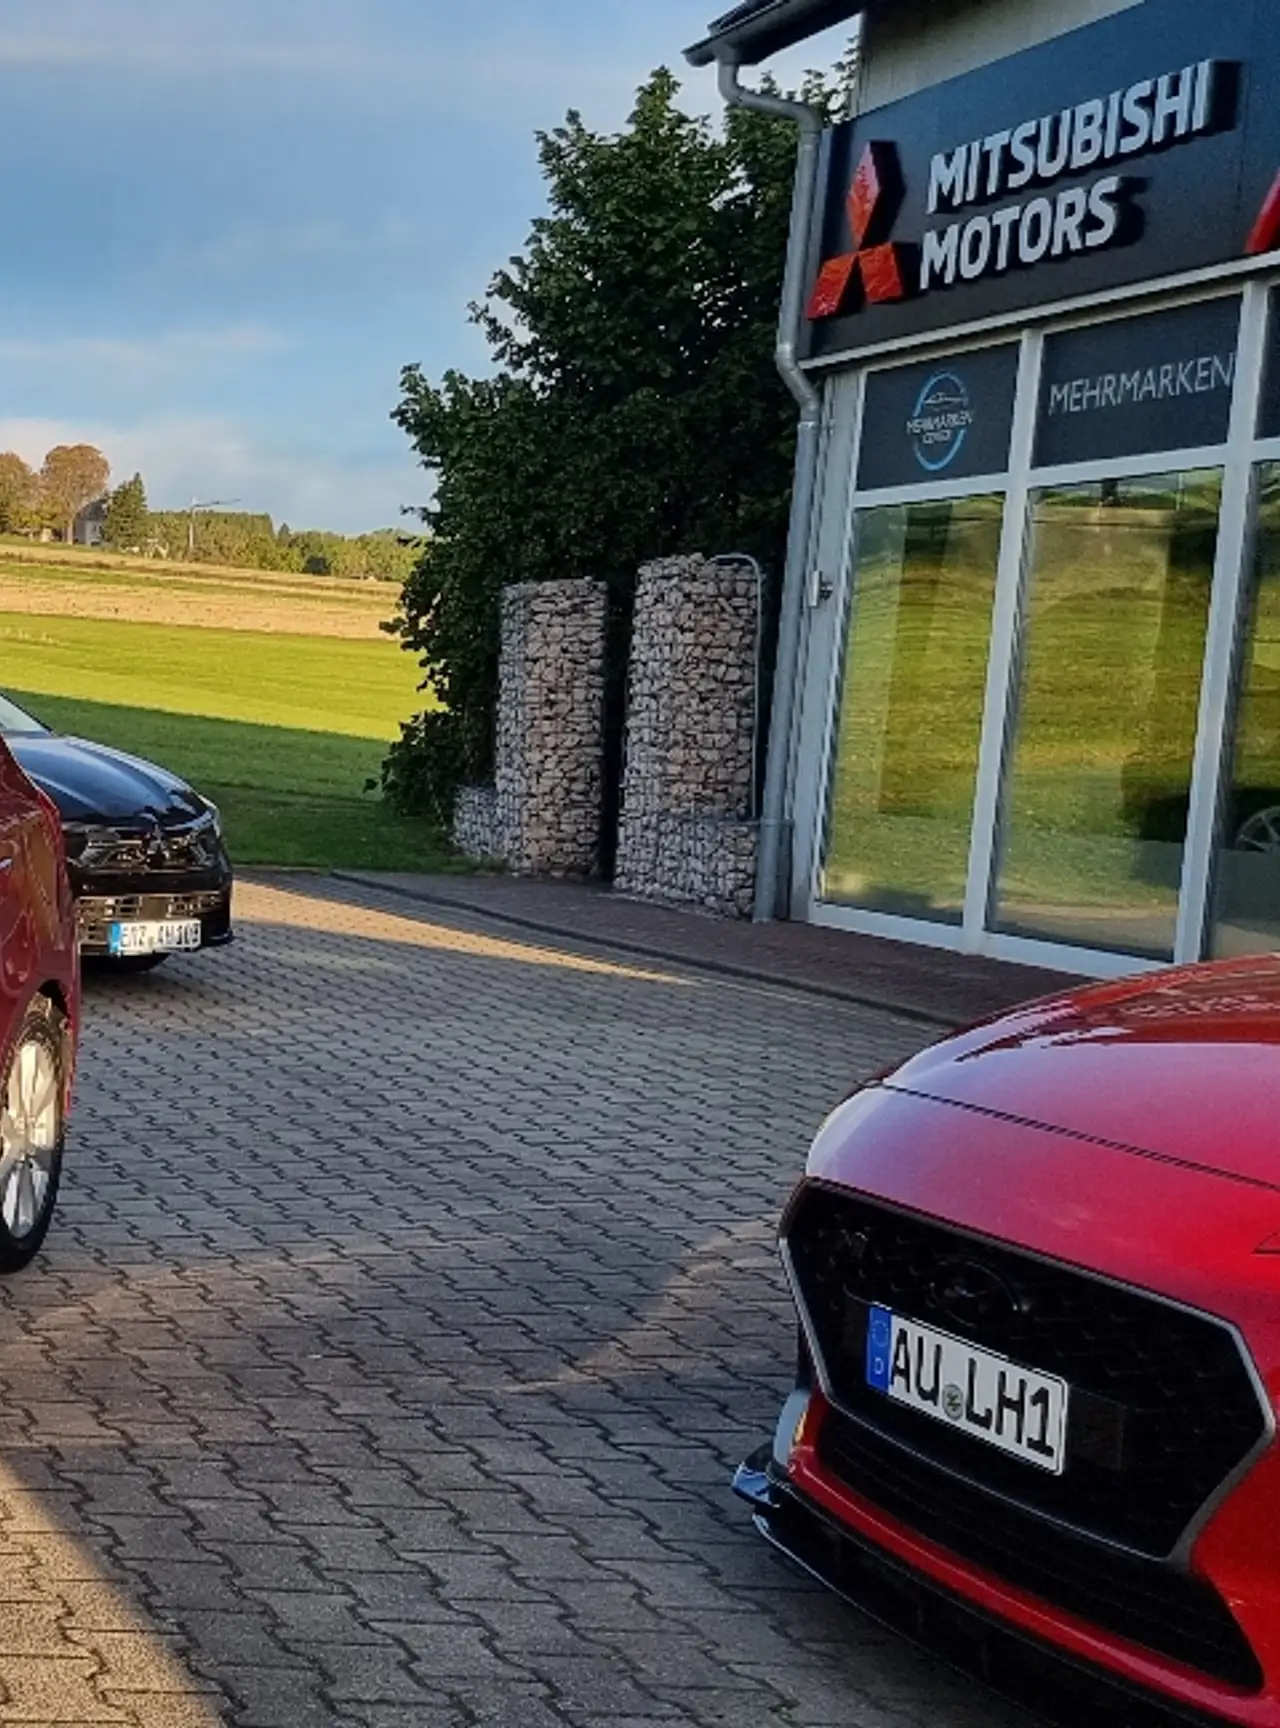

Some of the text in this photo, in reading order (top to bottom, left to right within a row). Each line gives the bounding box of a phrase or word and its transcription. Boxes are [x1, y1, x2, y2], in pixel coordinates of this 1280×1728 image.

[927, 58, 1212, 214] MITSUBISHI
[920, 174, 1119, 290] MOTORS
[1047, 352, 1236, 416] MEHRMARKEN
[890, 1327, 1055, 1457] AU LH1
